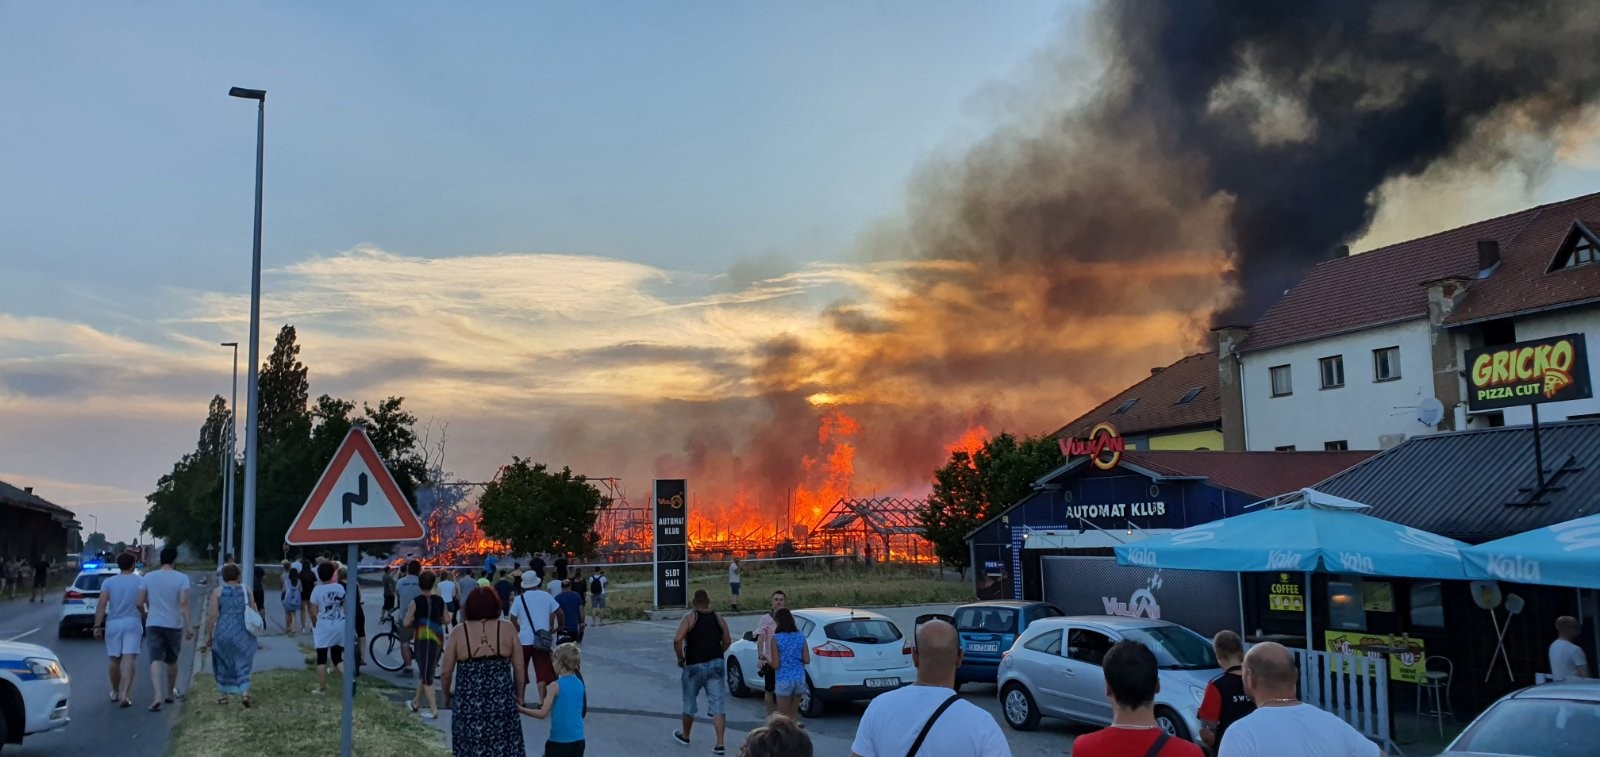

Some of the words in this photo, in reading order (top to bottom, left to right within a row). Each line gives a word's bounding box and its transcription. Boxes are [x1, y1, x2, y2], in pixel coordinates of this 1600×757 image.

[1472, 340, 1573, 387] GRICKO
[1477, 387, 1513, 401] PIZZA
[1515, 383, 1540, 396] CUT
[1065, 503, 1126, 519] AUTOMAT
[1131, 501, 1166, 517] KLUB
[658, 517, 684, 526] AUTOMAT
[1127, 547, 1157, 566] Kala
[1266, 550, 1302, 569] Kala
[664, 568, 680, 577] SLOT
[1487, 553, 1541, 580] Kala
[665, 579, 680, 588] HALL
[1271, 583, 1299, 594] COFFEE
